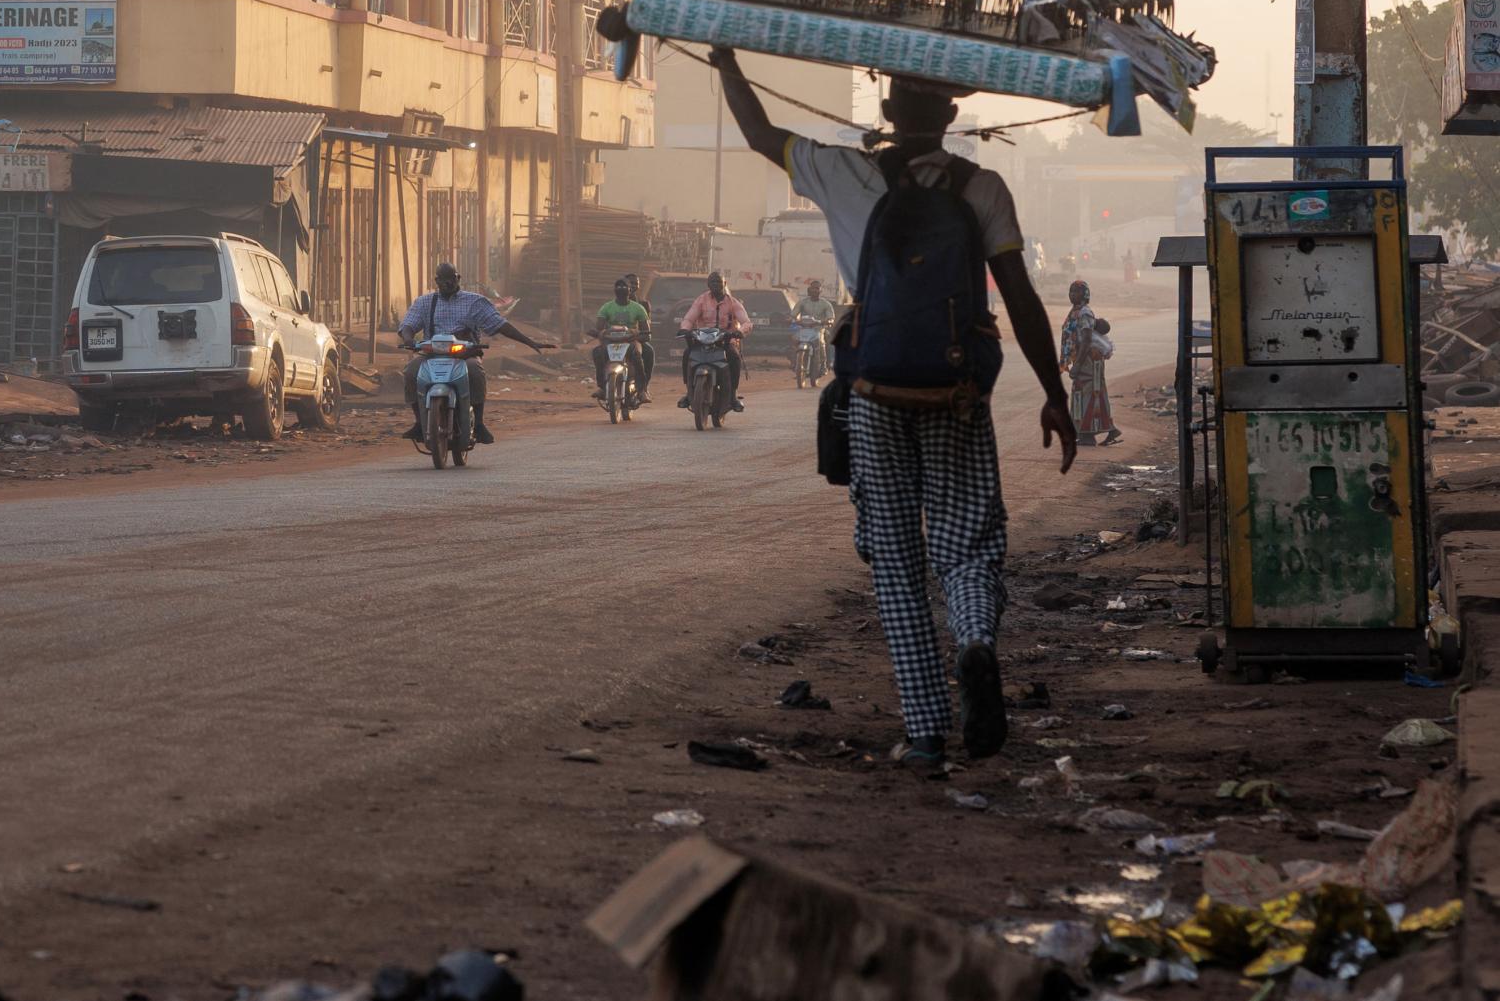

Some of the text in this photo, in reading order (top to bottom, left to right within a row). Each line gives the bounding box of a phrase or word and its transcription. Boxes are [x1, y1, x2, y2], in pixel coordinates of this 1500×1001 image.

[1469, 20, 1498, 29] TOYOTA
[53, 38, 78, 47] 2023
[3, 155, 47, 167] FRERE
[97, 328, 108, 338] AF
